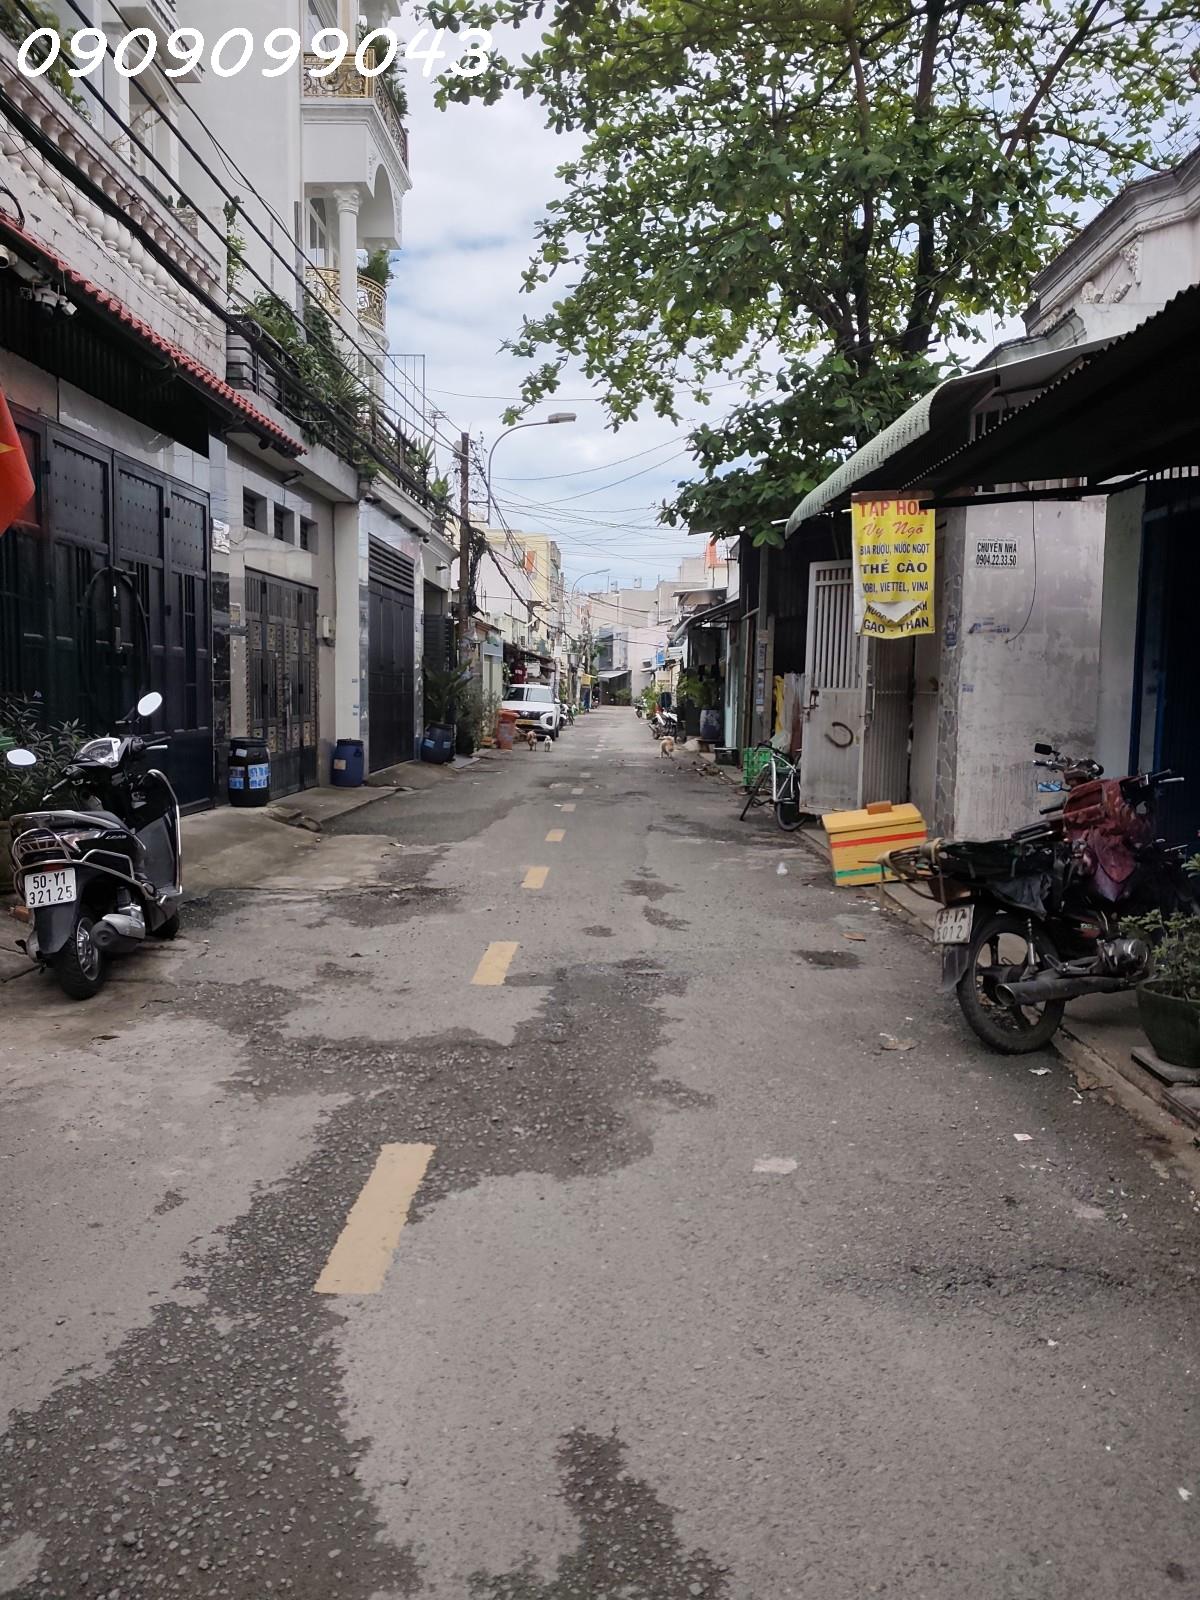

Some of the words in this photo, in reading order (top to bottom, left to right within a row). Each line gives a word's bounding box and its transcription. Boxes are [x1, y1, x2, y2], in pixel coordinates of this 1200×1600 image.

[860, 545, 871, 556] BIA
[897, 560, 928, 573] CÀO
[880, 581, 909, 593] VIETTEL,
[911, 581, 929, 592] VINA
[898, 617, 929, 633] THAN
[29, 885, 73, 905] 321.25
